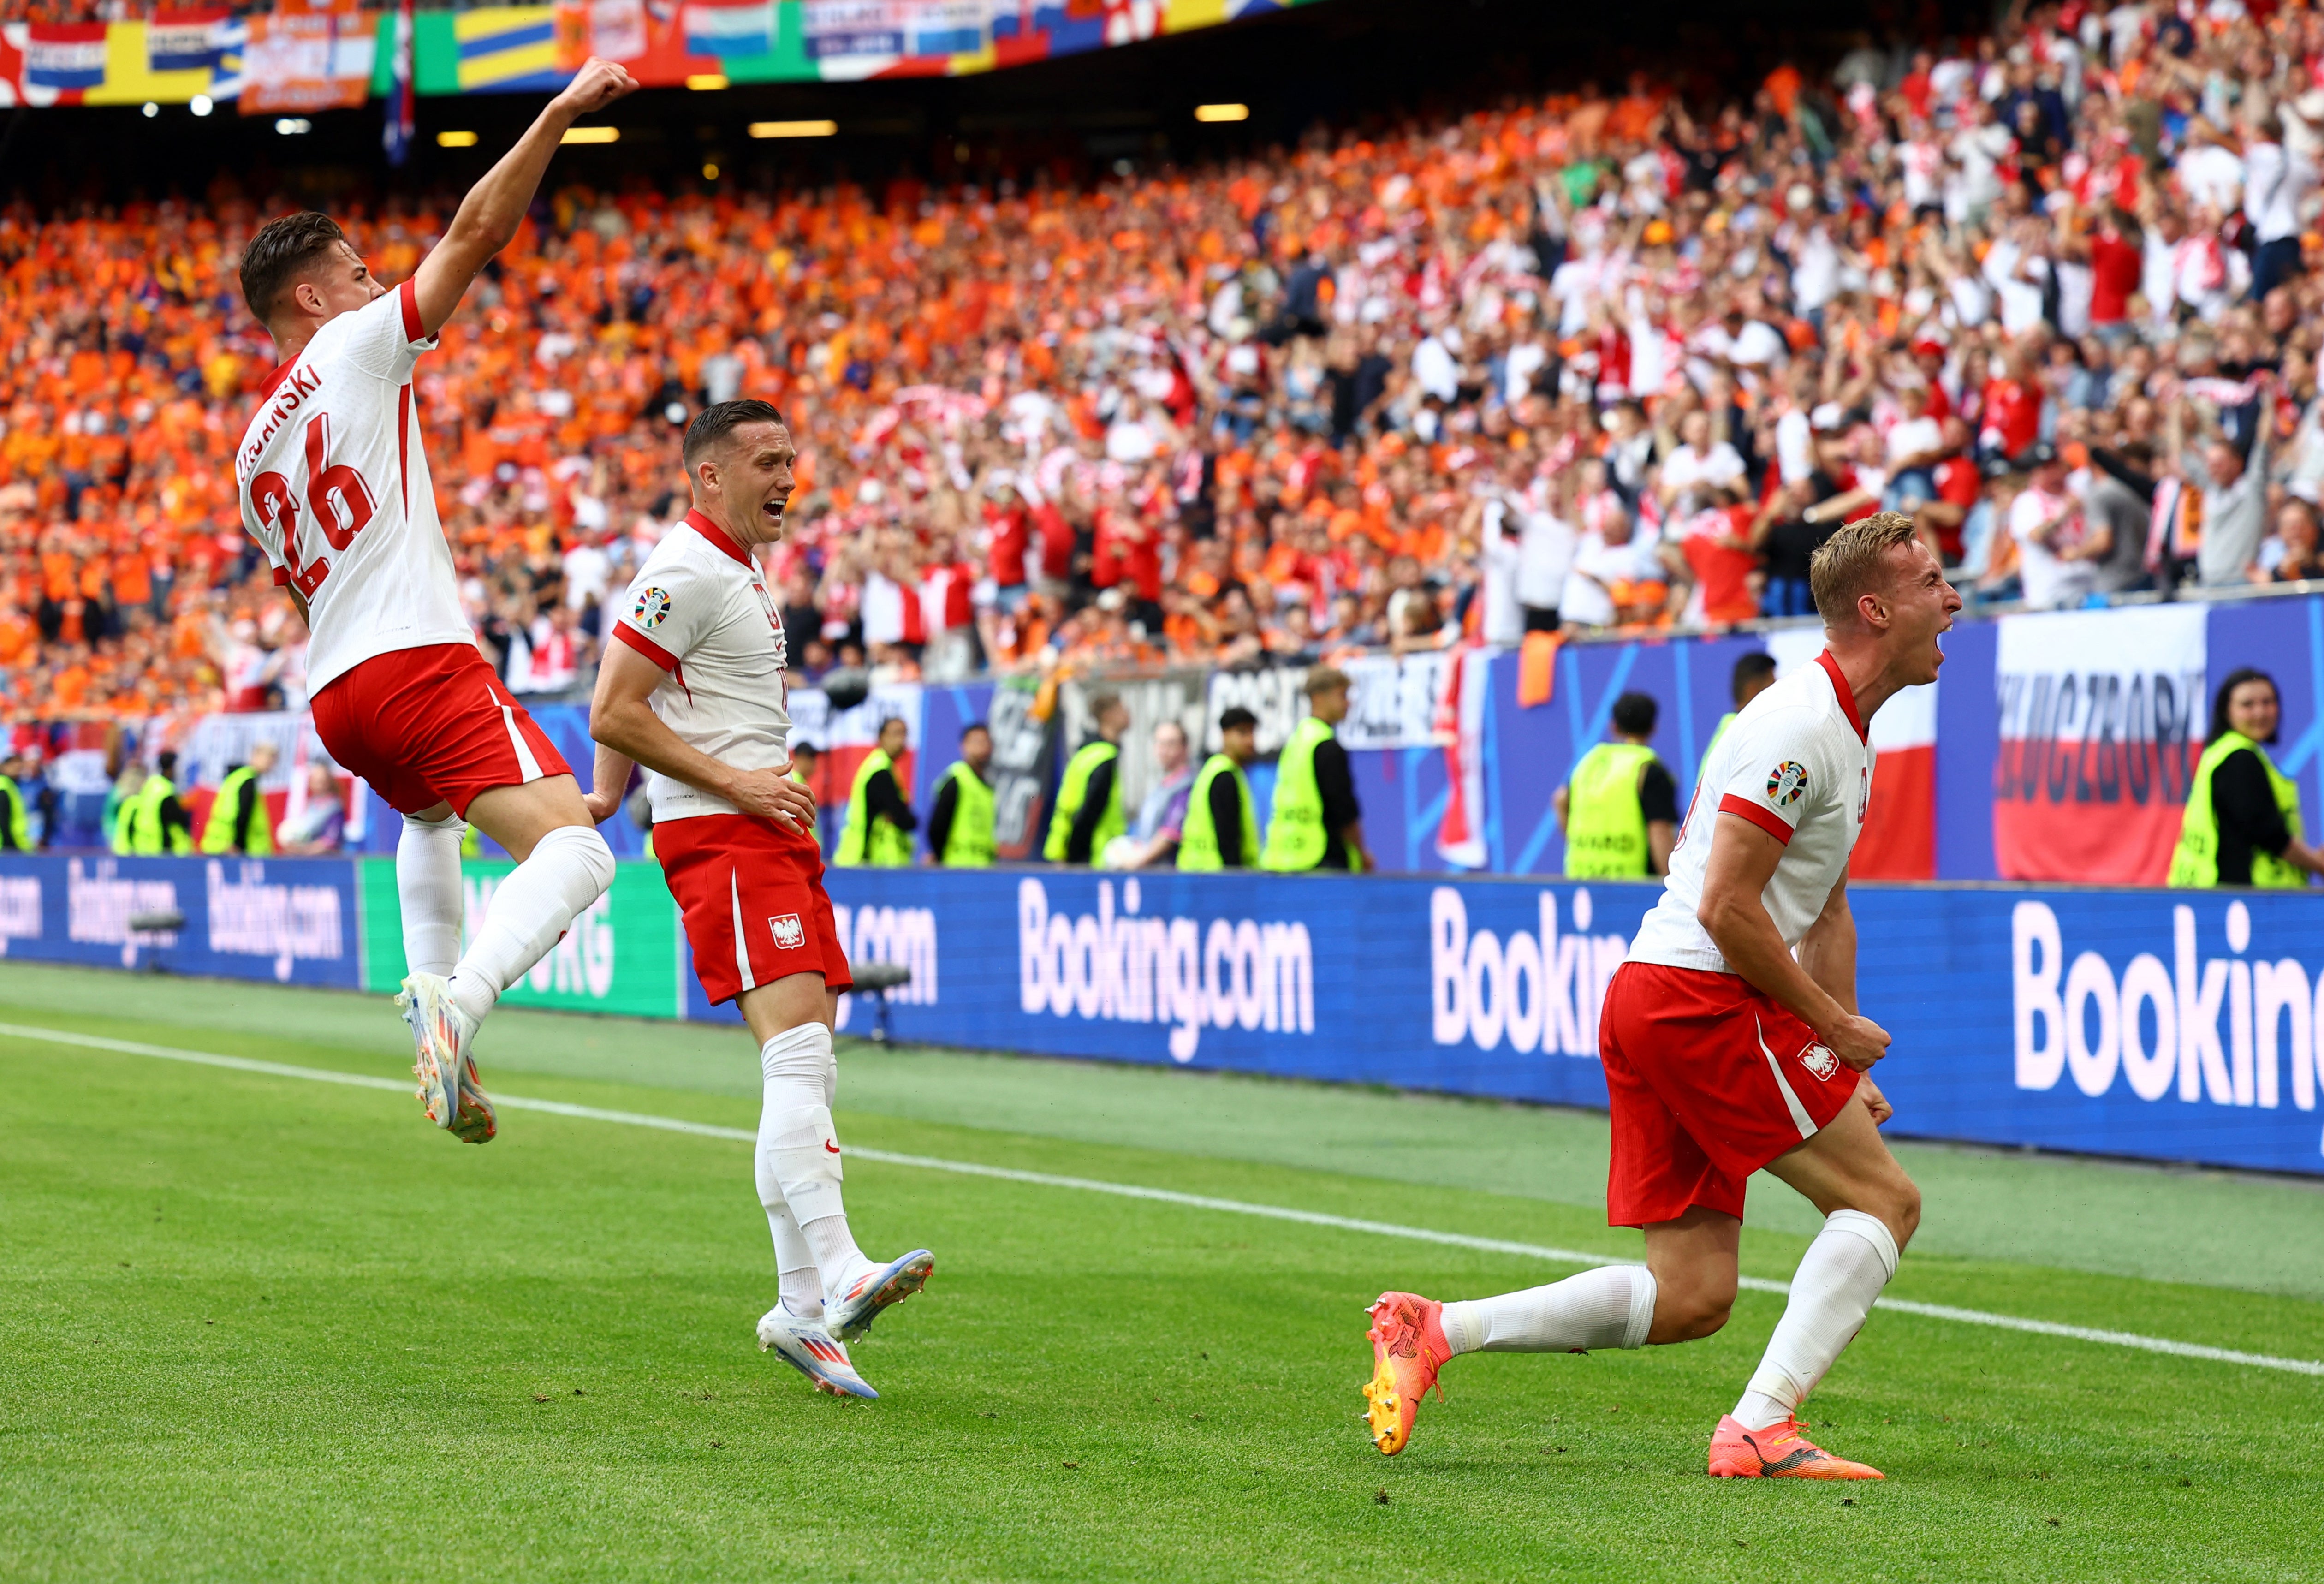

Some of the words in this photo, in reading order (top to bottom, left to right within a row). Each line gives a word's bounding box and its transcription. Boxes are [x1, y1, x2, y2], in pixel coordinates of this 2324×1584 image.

[250, 411, 378, 606] 26
[1019, 877, 1315, 1063] Booking.com
[2011, 899, 2324, 1158] Bookin
[788, 1328, 828, 1341] F50
